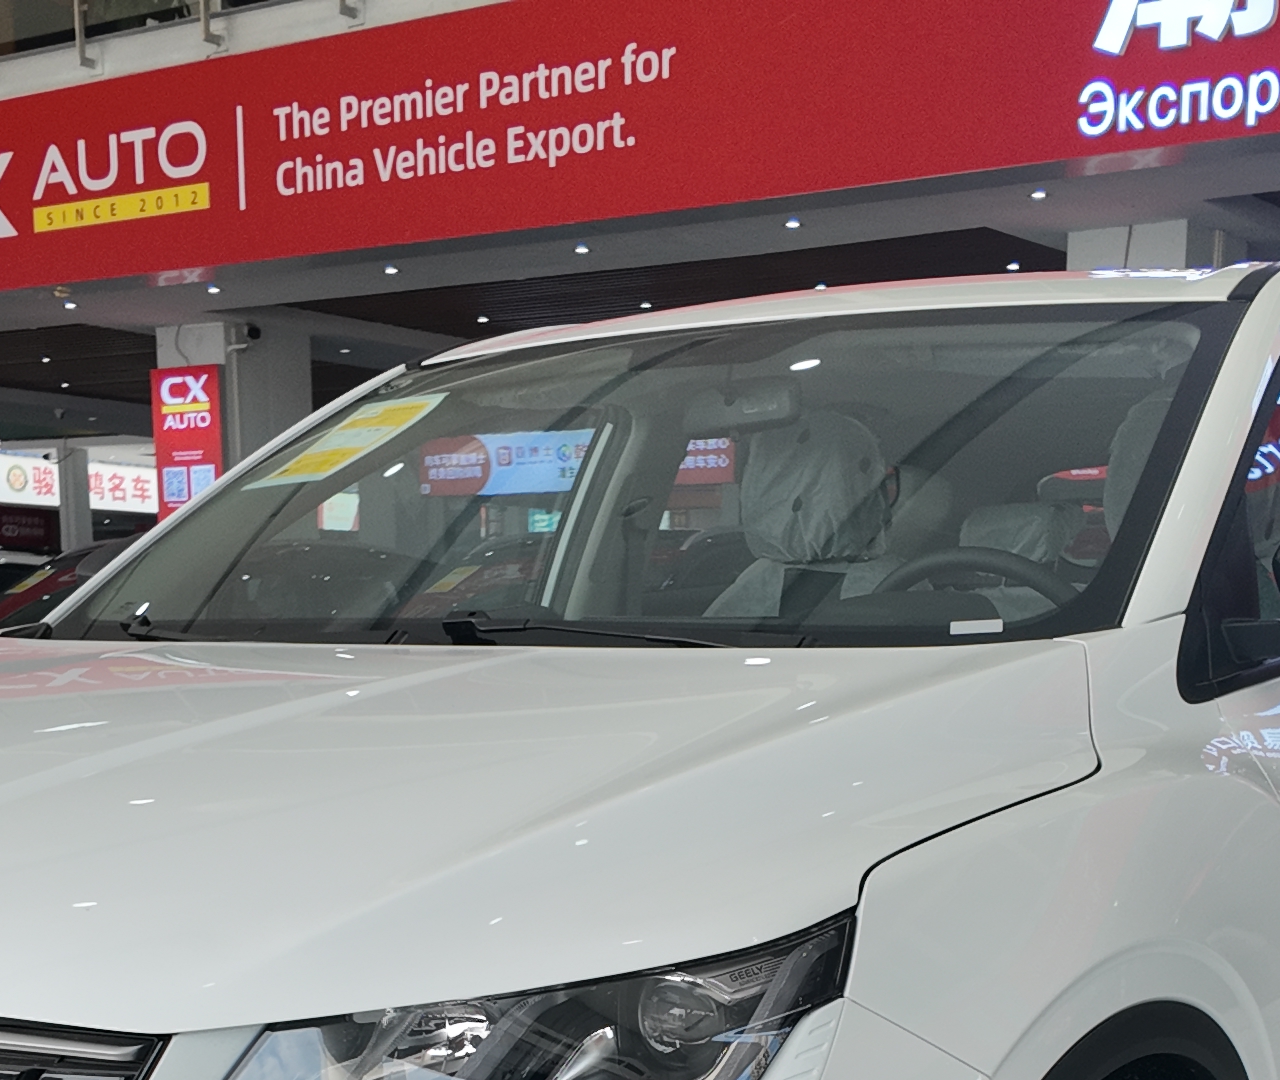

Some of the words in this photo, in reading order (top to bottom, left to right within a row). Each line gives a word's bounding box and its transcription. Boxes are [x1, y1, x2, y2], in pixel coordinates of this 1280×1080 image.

[273, 104, 331, 143] The
[340, 84, 469, 133] Premier
[479, 65, 613, 111] Partner
[620, 42, 677, 86] for
[32, 120, 208, 200] AUTO
[276, 153, 365, 198] China
[373, 131, 496, 182] Vehicle
[507, 112, 637, 170] Export.
[45, 201, 120, 228] SINCE
[138, 189, 202, 214] 2012
[160, 374, 210, 406] CX
[163, 411, 212, 431] AUTO
[729, 964, 765, 983] GEELY
